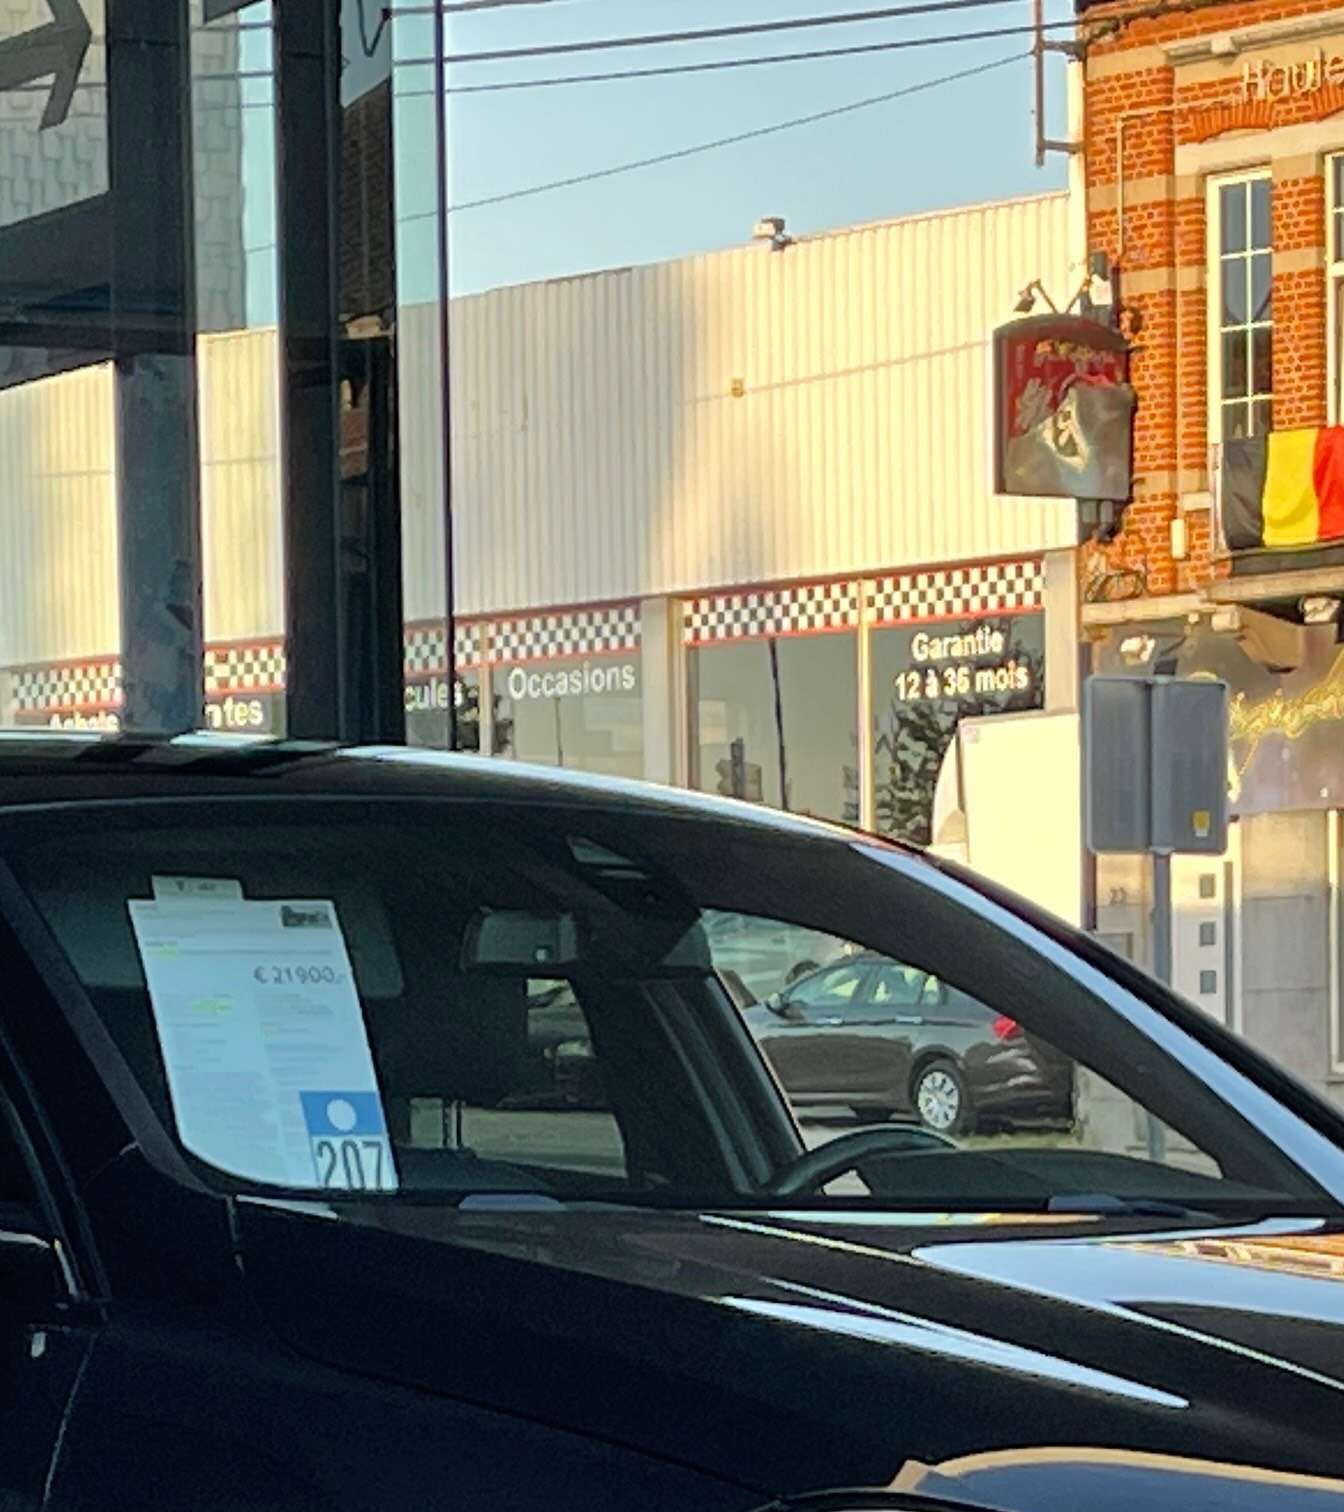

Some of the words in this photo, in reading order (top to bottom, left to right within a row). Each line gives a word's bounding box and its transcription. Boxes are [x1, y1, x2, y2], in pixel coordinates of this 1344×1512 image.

[911, 624, 1004, 661] Garantie
[508, 662, 636, 700] Occasions
[895, 669, 921, 701] 12
[925, 668, 939, 698] à
[975, 660, 1029, 692] mois
[205, 696, 264, 729] ntes
[317, 1140, 383, 1190] 207
